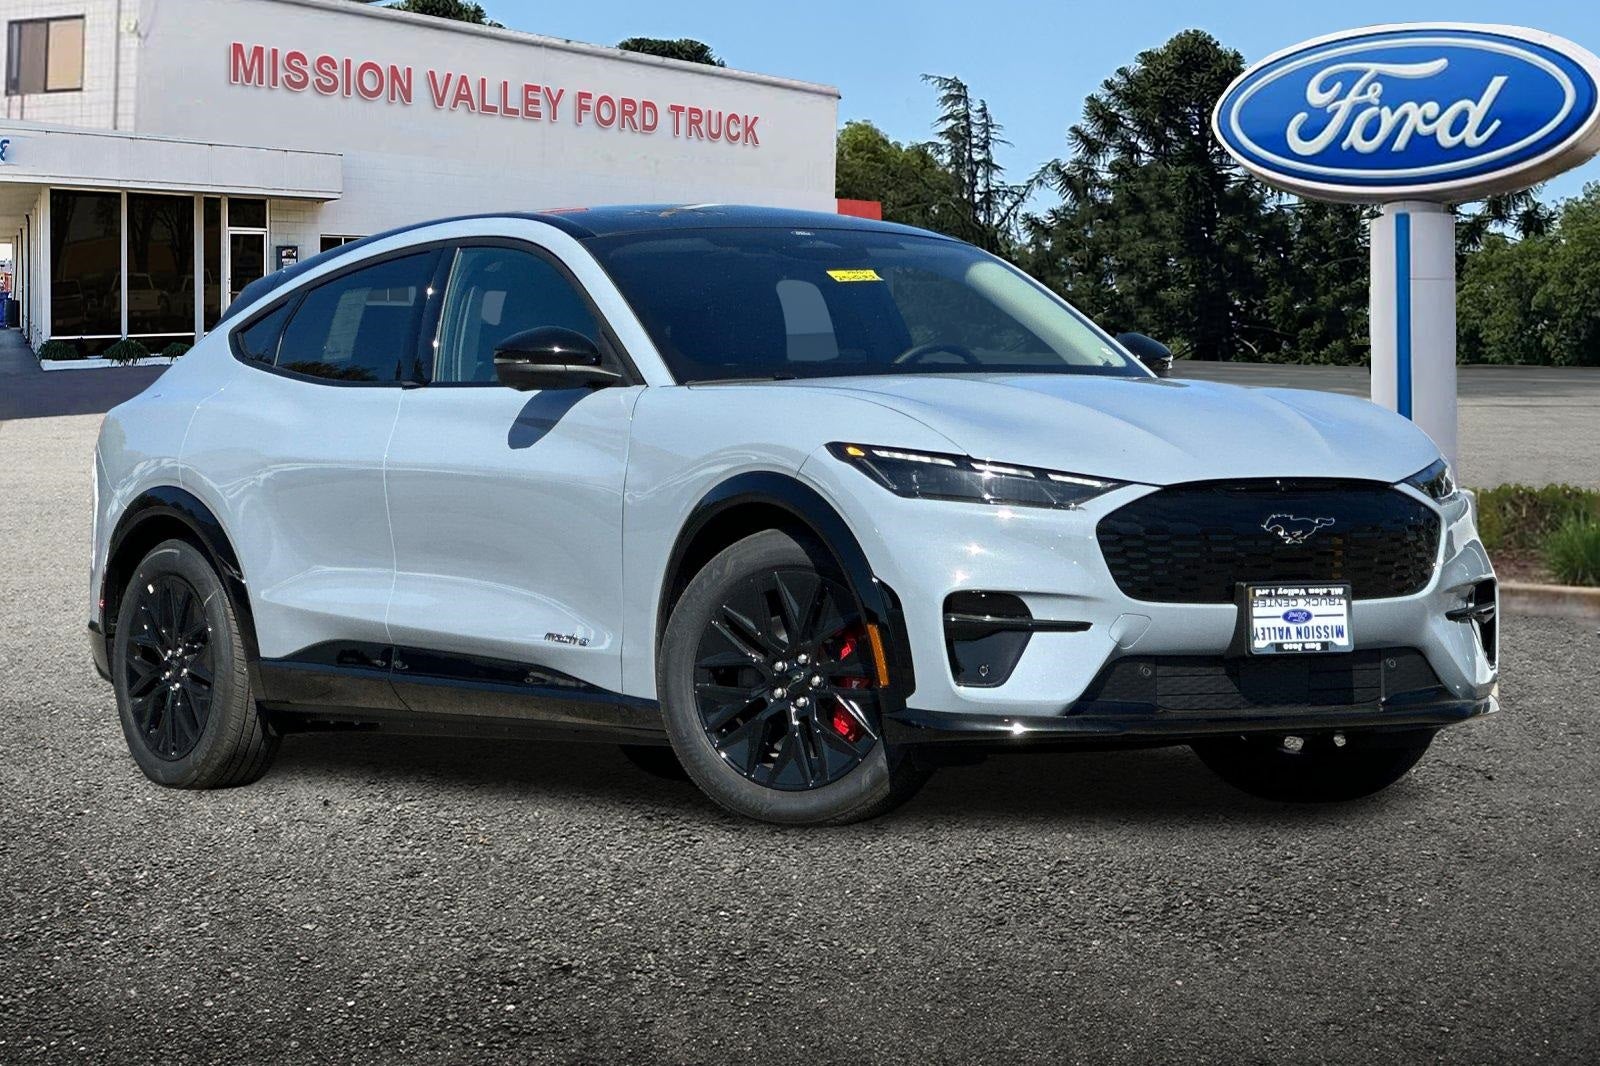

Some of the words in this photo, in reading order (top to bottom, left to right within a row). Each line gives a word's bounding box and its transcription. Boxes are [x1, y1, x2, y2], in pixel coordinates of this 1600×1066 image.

[229, 41, 414, 104] MISSION
[427, 69, 565, 122] VALLEY
[576, 90, 659, 134] FORD
[669, 103, 761, 146] TRUCK
[1286, 57, 1509, 157] Ford
[1309, 587, 1344, 595] Mision
[1304, 598, 1343, 606] TRUCK
[1287, 611, 1308, 622] Ford
[1254, 626, 1291, 640] VALLEY
[1297, 625, 1344, 639] MISSION
